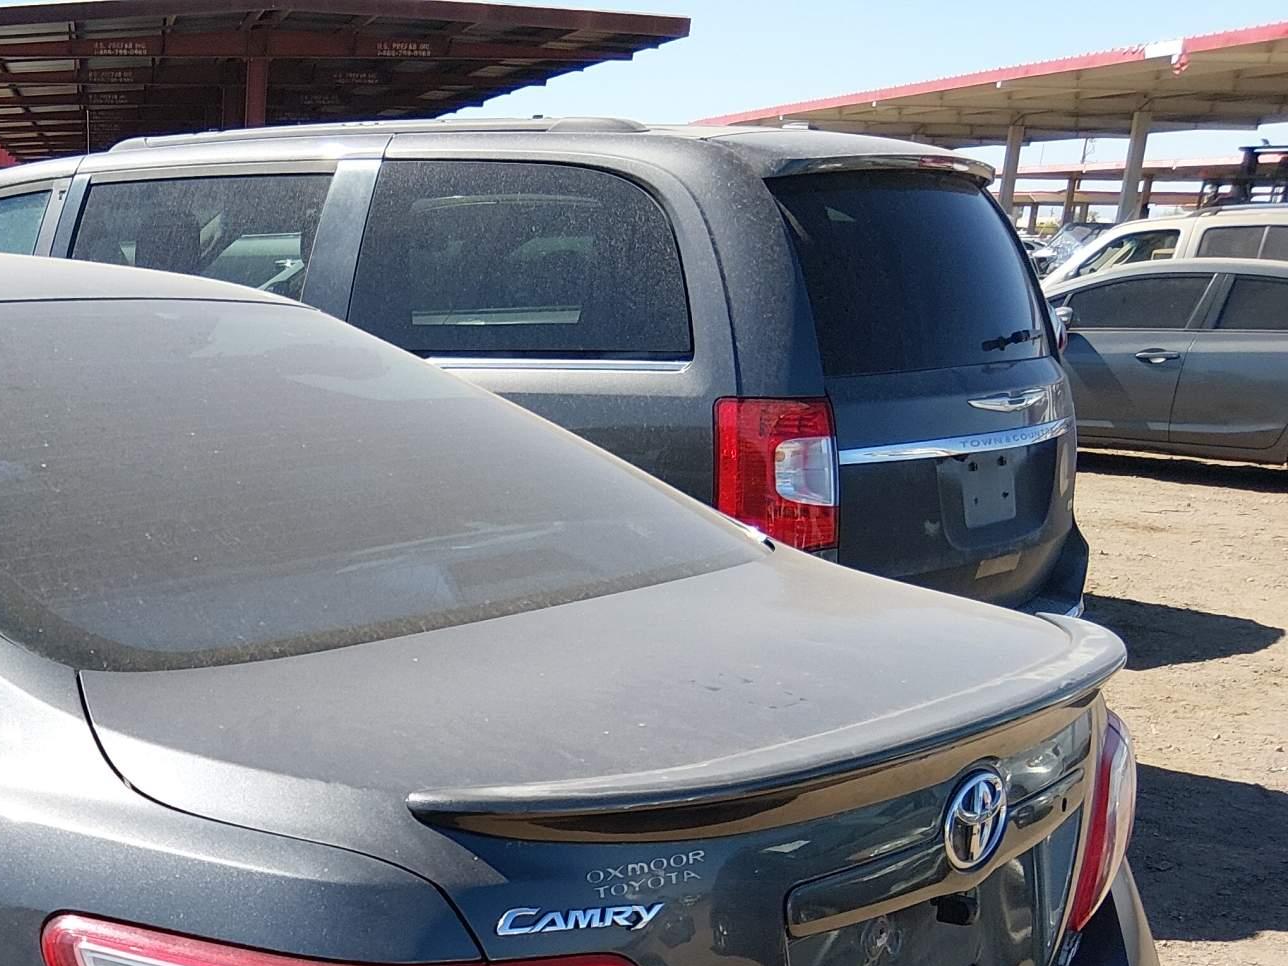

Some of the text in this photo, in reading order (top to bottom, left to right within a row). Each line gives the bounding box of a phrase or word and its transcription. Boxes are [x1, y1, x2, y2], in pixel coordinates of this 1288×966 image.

[587, 850, 705, 883] OXMOOR
[593, 869, 702, 898] TOYOTA
[496, 902, 666, 936] CAMRY
